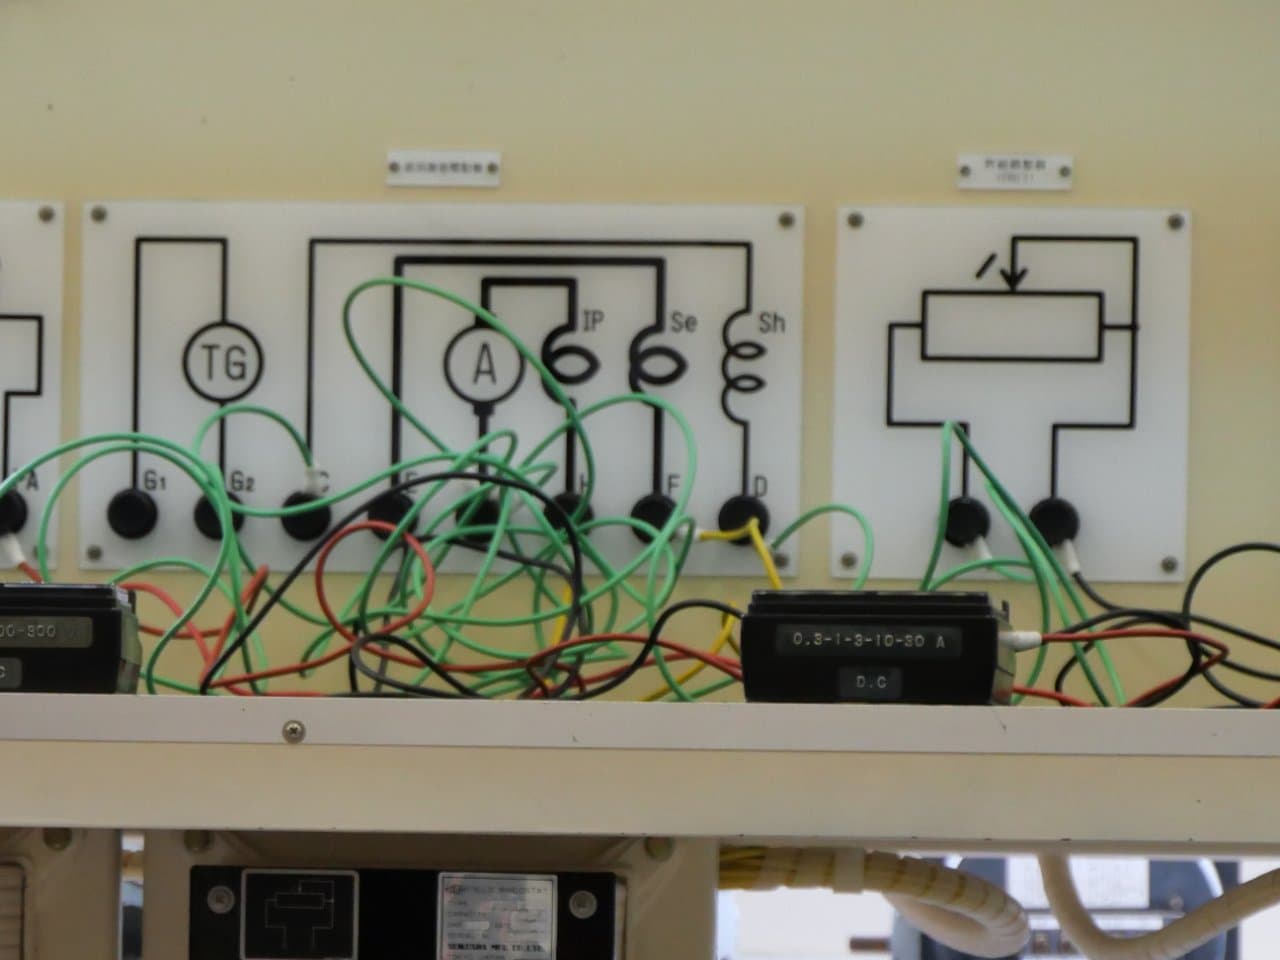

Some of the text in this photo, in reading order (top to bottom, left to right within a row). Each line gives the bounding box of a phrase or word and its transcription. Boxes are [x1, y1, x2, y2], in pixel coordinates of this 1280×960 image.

[582, 309, 604, 332] IP
[670, 310, 698, 333] Se
[759, 311, 787, 334] Sh
[201, 344, 247, 381] TG
[473, 342, 497, 385] A
[754, 475, 767, 497] D
[793, 631, 946, 649] 0.3-1-3-10-30 A
